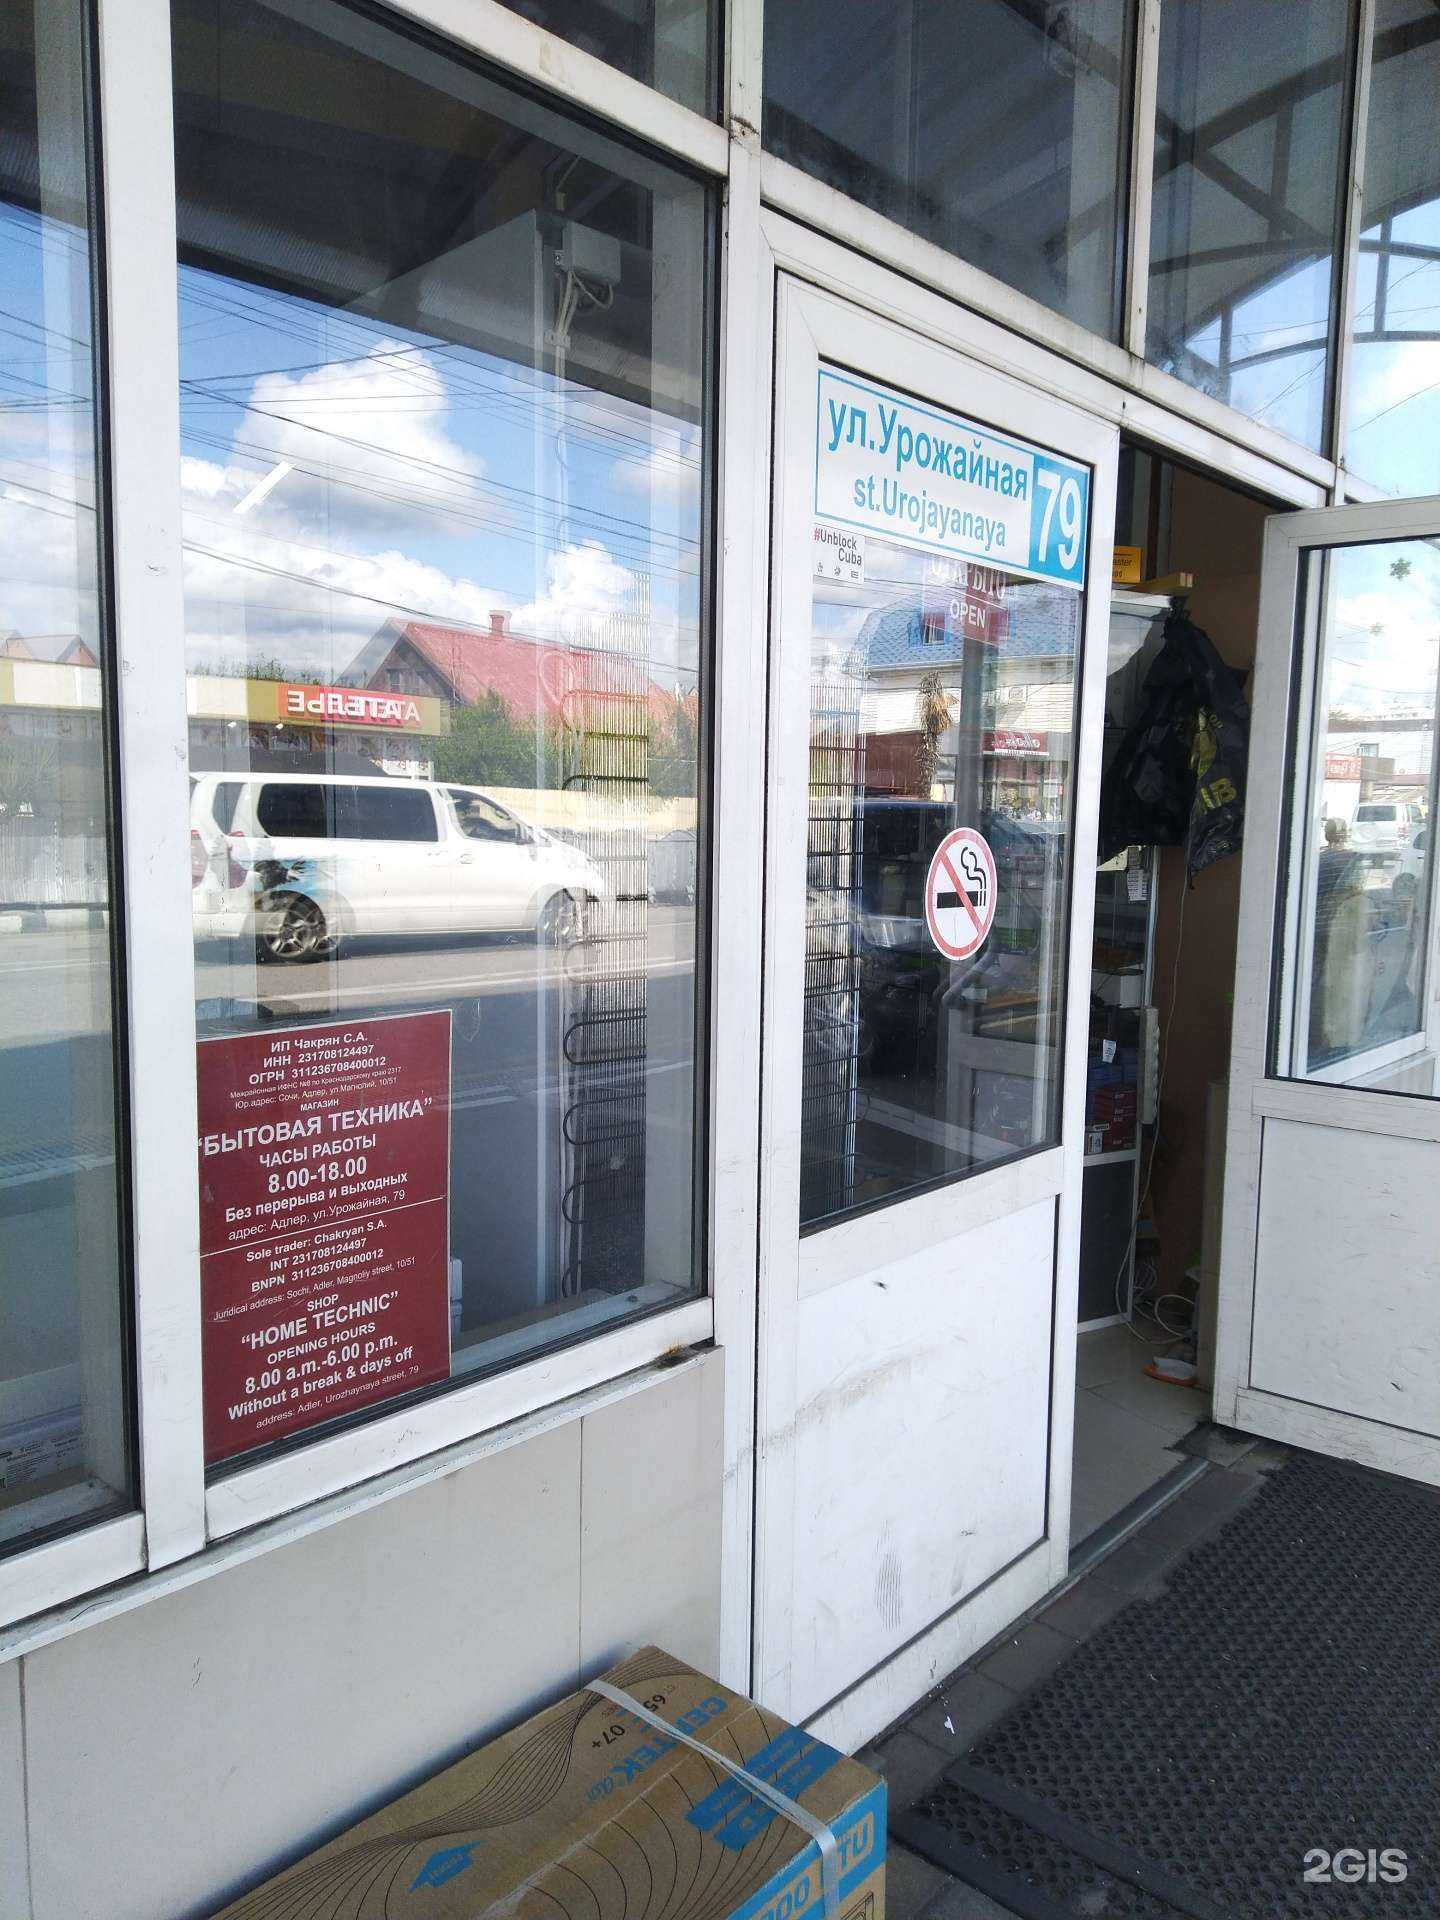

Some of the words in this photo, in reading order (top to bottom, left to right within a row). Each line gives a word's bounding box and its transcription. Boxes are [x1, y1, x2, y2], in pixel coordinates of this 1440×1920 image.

[828, 398, 1027, 500] ул.Урожайная
[854, 475, 1006, 551] st.Urojayanaya
[1036, 468, 1082, 570] 79
[814, 527, 857, 550] #Unblock
[838, 549, 862, 566] Cuba
[950, 599, 986, 628] OPEN
[264, 1055, 291, 1068] ИНН
[298, 1045, 374, 1063] 231708124497
[271, 1041, 290, 1052] ИП
[295, 1036, 340, 1049] Чакрян
[344, 1032, 368, 1043] С.А.
[249, 1070, 284, 1084] ОГРН
[292, 1056, 386, 1078] 311236708400012
[300, 1099, 338, 1111] МАГАЗИН
[260, 1146, 307, 1168] ЧАСЫ
[312, 1134, 376, 1159] РАБОТЫ
[268, 1156, 367, 1194] 8.00-18.00
[226, 1206, 251, 1222] Без
[256, 1191, 324, 1216] перерыва
[329, 1188, 337, 1198] и
[341, 1173, 408, 1196] выходных
[228, 1224, 267, 1240] адрес:
[270, 1212, 310, 1231] Адлер,
[313, 1195, 390, 1222] ул.Урожайная,
[393, 1190, 406, 1200] 79
[246, 1249, 271, 1262] Sole
[275, 1239, 311, 1255] trader:
[314, 1225, 364, 1246] Chakryan
[367, 1220, 387, 1232] S.A.
[270, 1258, 289, 1271] INT
[292, 1238, 367, 1266] 231708124497
[252, 1275, 285, 1292] BNPN
[292, 1249, 384, 1283] 311236708400012
[214, 1303, 248, 1320] Juridical
[250, 1295, 284, 1310] address:
[307, 1295, 339, 1312] SHOP
[267, 1339, 327, 1365] OPENING
[331, 1322, 376, 1344] HOURS
[245, 1368, 281, 1394] 8.00
[286, 1342, 360, 1380] a.m.-6.00
[365, 1333, 398, 1356] p.m.
[228, 1392, 287, 1420] Without
[291, 1388, 299, 1399] a
[303, 1374, 342, 1395] break
[346, 1366, 356, 1378] &
[360, 1356, 392, 1376] days
[395, 1347, 414, 1363] off
[256, 1411, 295, 1429] address:
[297, 1400, 323, 1415] Adler,
[325, 1379, 380, 1404] Urozhaynaya
[382, 1371, 408, 1386] street,
[409, 1364, 419, 1375] 79
